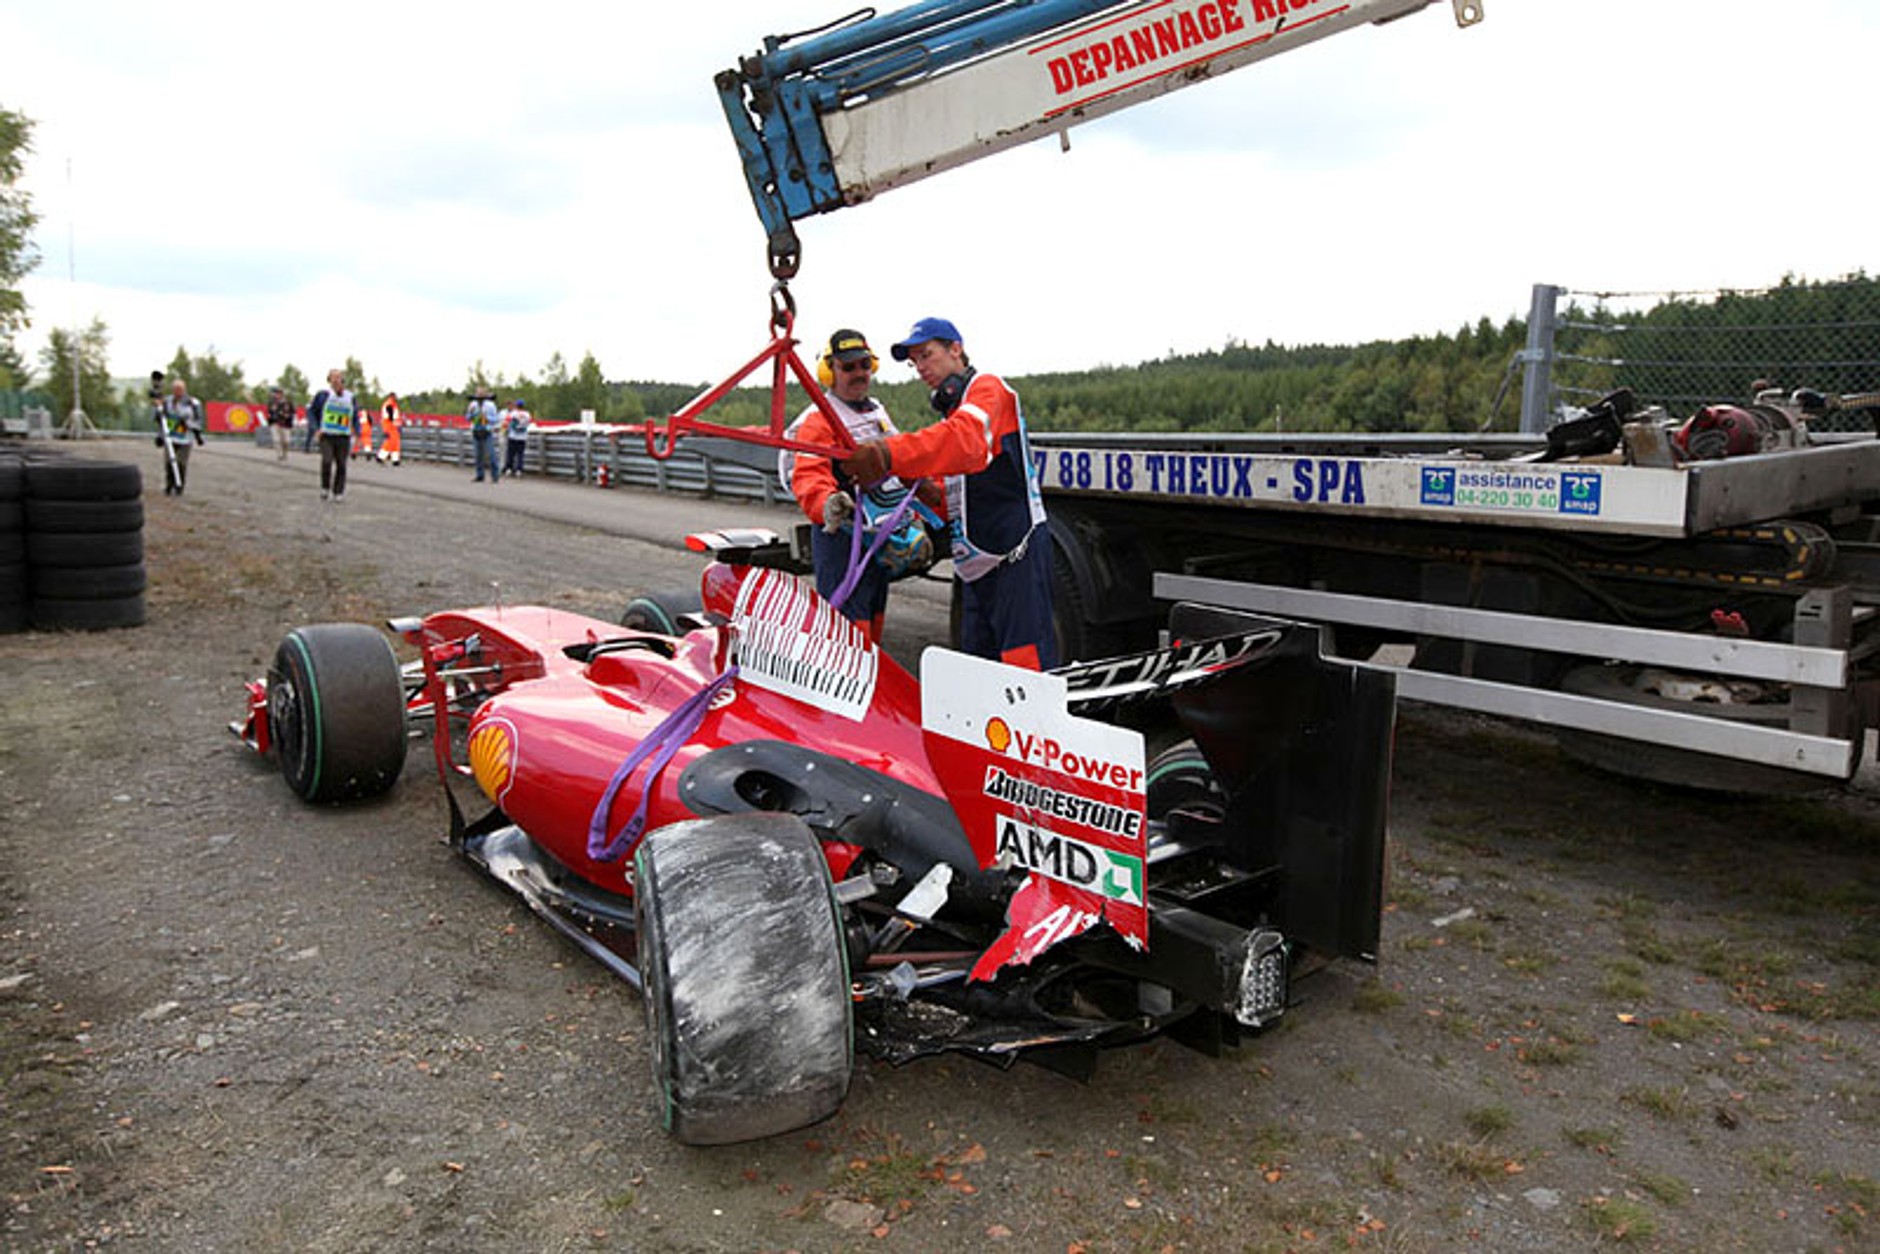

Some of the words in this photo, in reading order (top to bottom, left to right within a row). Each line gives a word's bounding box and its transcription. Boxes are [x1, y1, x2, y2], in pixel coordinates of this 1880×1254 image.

[1048, 0, 1244, 95] DEPANNAGE
[1059, 451, 1092, 488] 88
[1105, 453, 1133, 491] 18
[1146, 455, 1252, 497] THEUX
[1293, 459, 1365, 504] SPA
[1459, 473, 1557, 490] assistance
[1512, 493, 1533, 507] 30
[1537, 494, 1557, 508] 40
[1565, 501, 1597, 513] smap
[1015, 730, 1143, 790] V-Power
[985, 769, 1141, 836] BRIDGESTONE
[998, 821, 1097, 885] AMD
